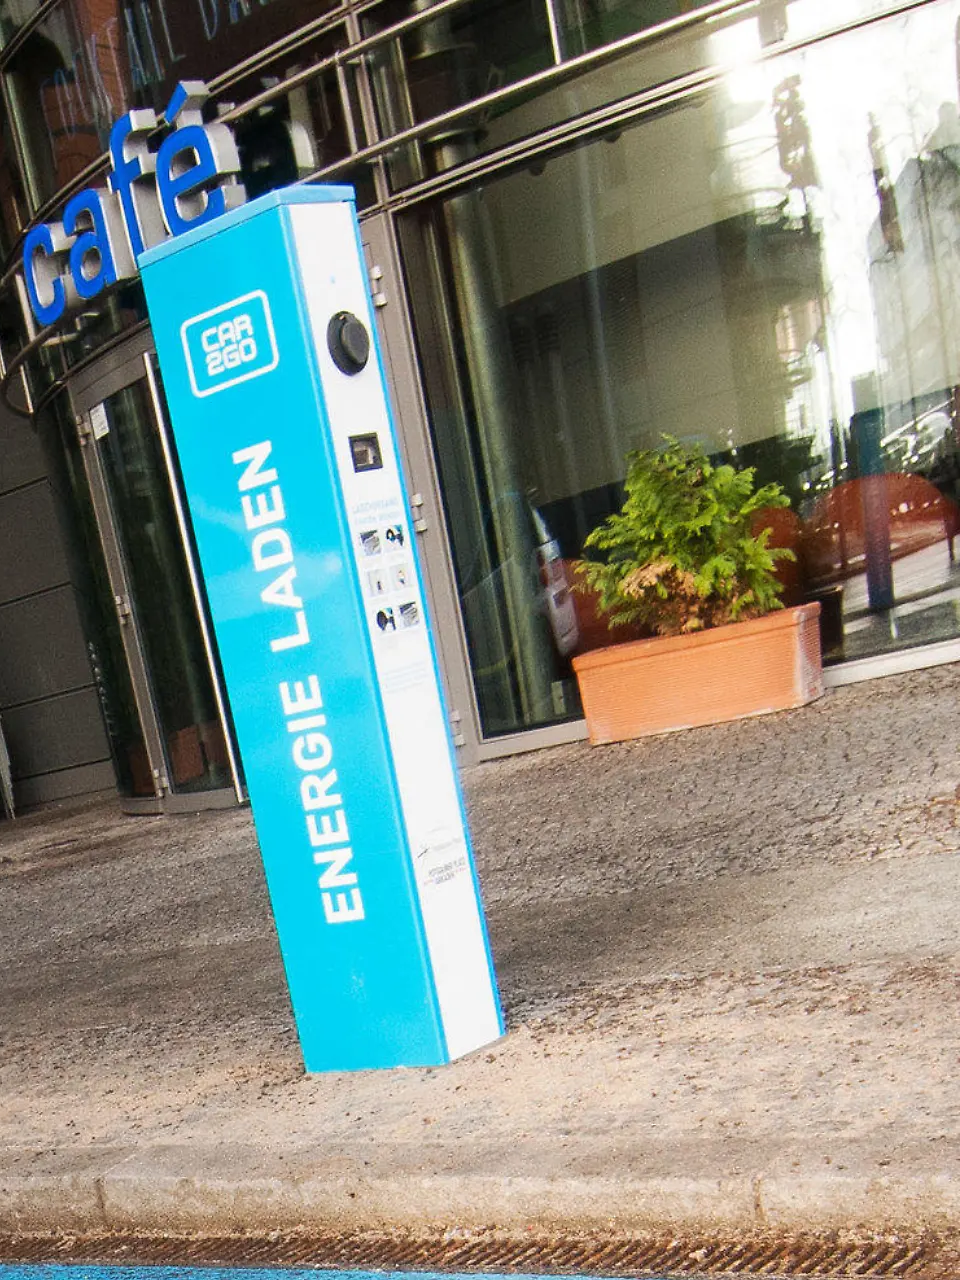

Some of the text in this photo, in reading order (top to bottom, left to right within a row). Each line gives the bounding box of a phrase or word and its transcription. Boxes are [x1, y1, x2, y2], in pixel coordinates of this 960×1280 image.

[24, 80, 240, 325] café
[201, 313, 254, 353] CAR
[205, 337, 258, 377] 2GO
[231, 439, 366, 924] ENERGIE LADEN
